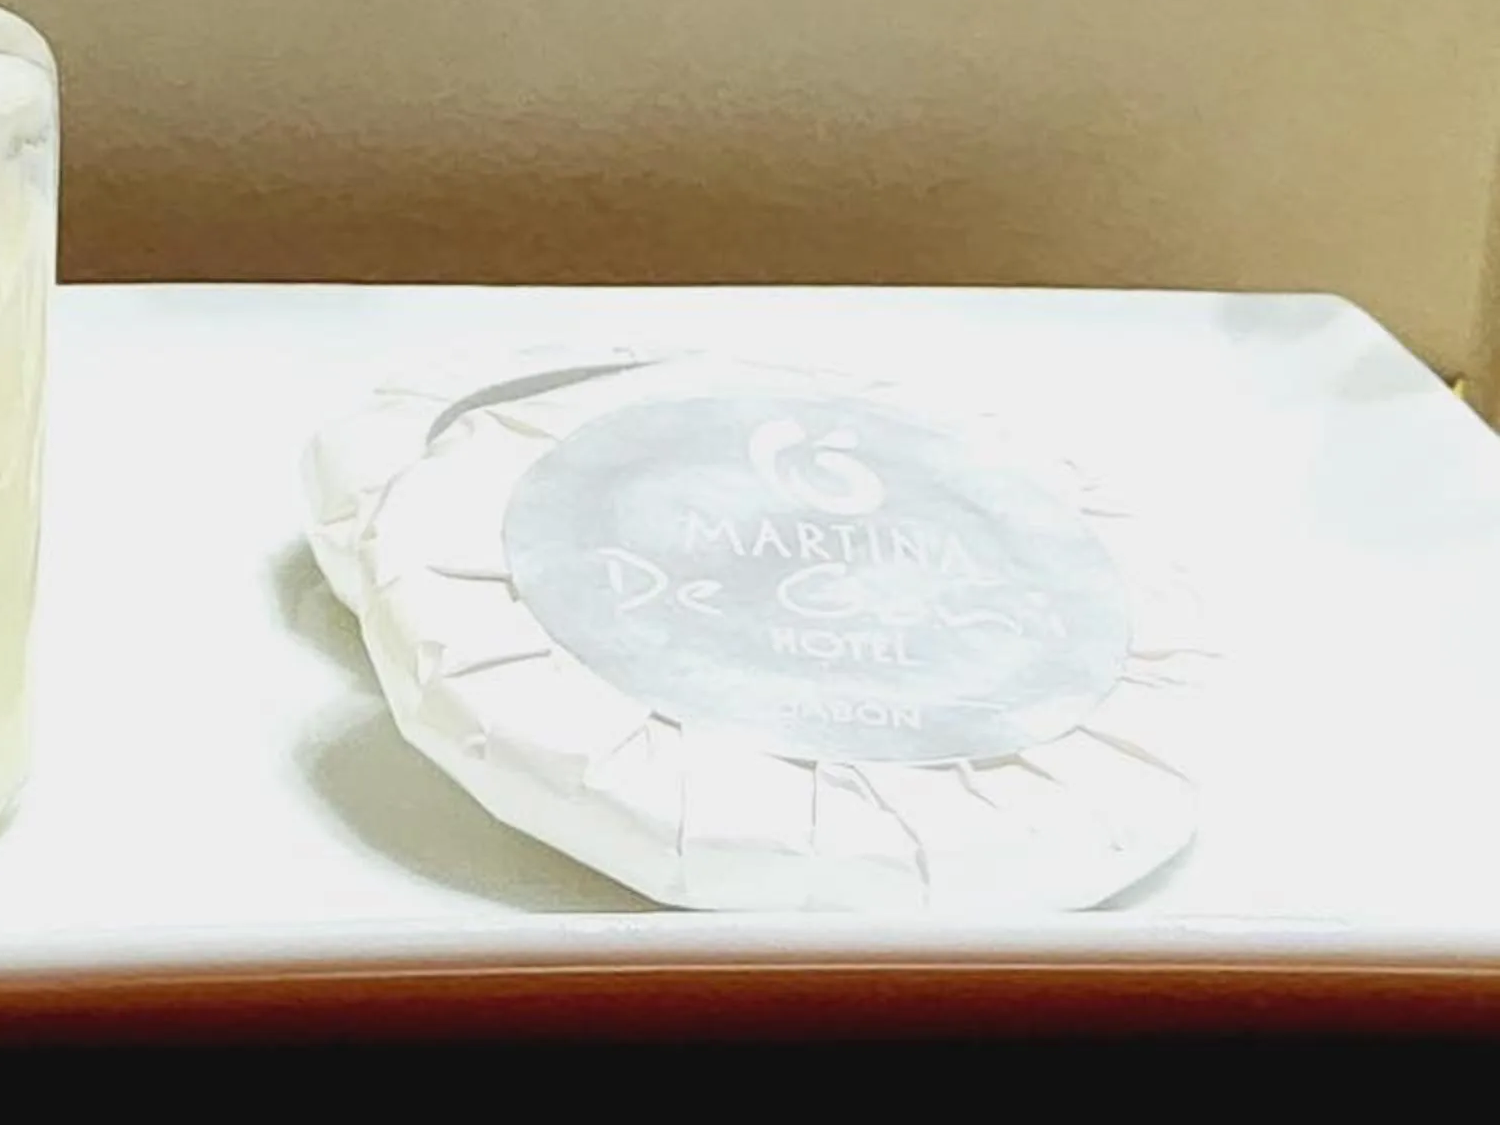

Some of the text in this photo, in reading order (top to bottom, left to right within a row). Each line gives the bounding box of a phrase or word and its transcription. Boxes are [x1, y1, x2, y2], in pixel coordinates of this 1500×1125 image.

[681, 510, 975, 573] MARTINA
[597, 546, 726, 618] De
[769, 625, 928, 667] HOTEL
